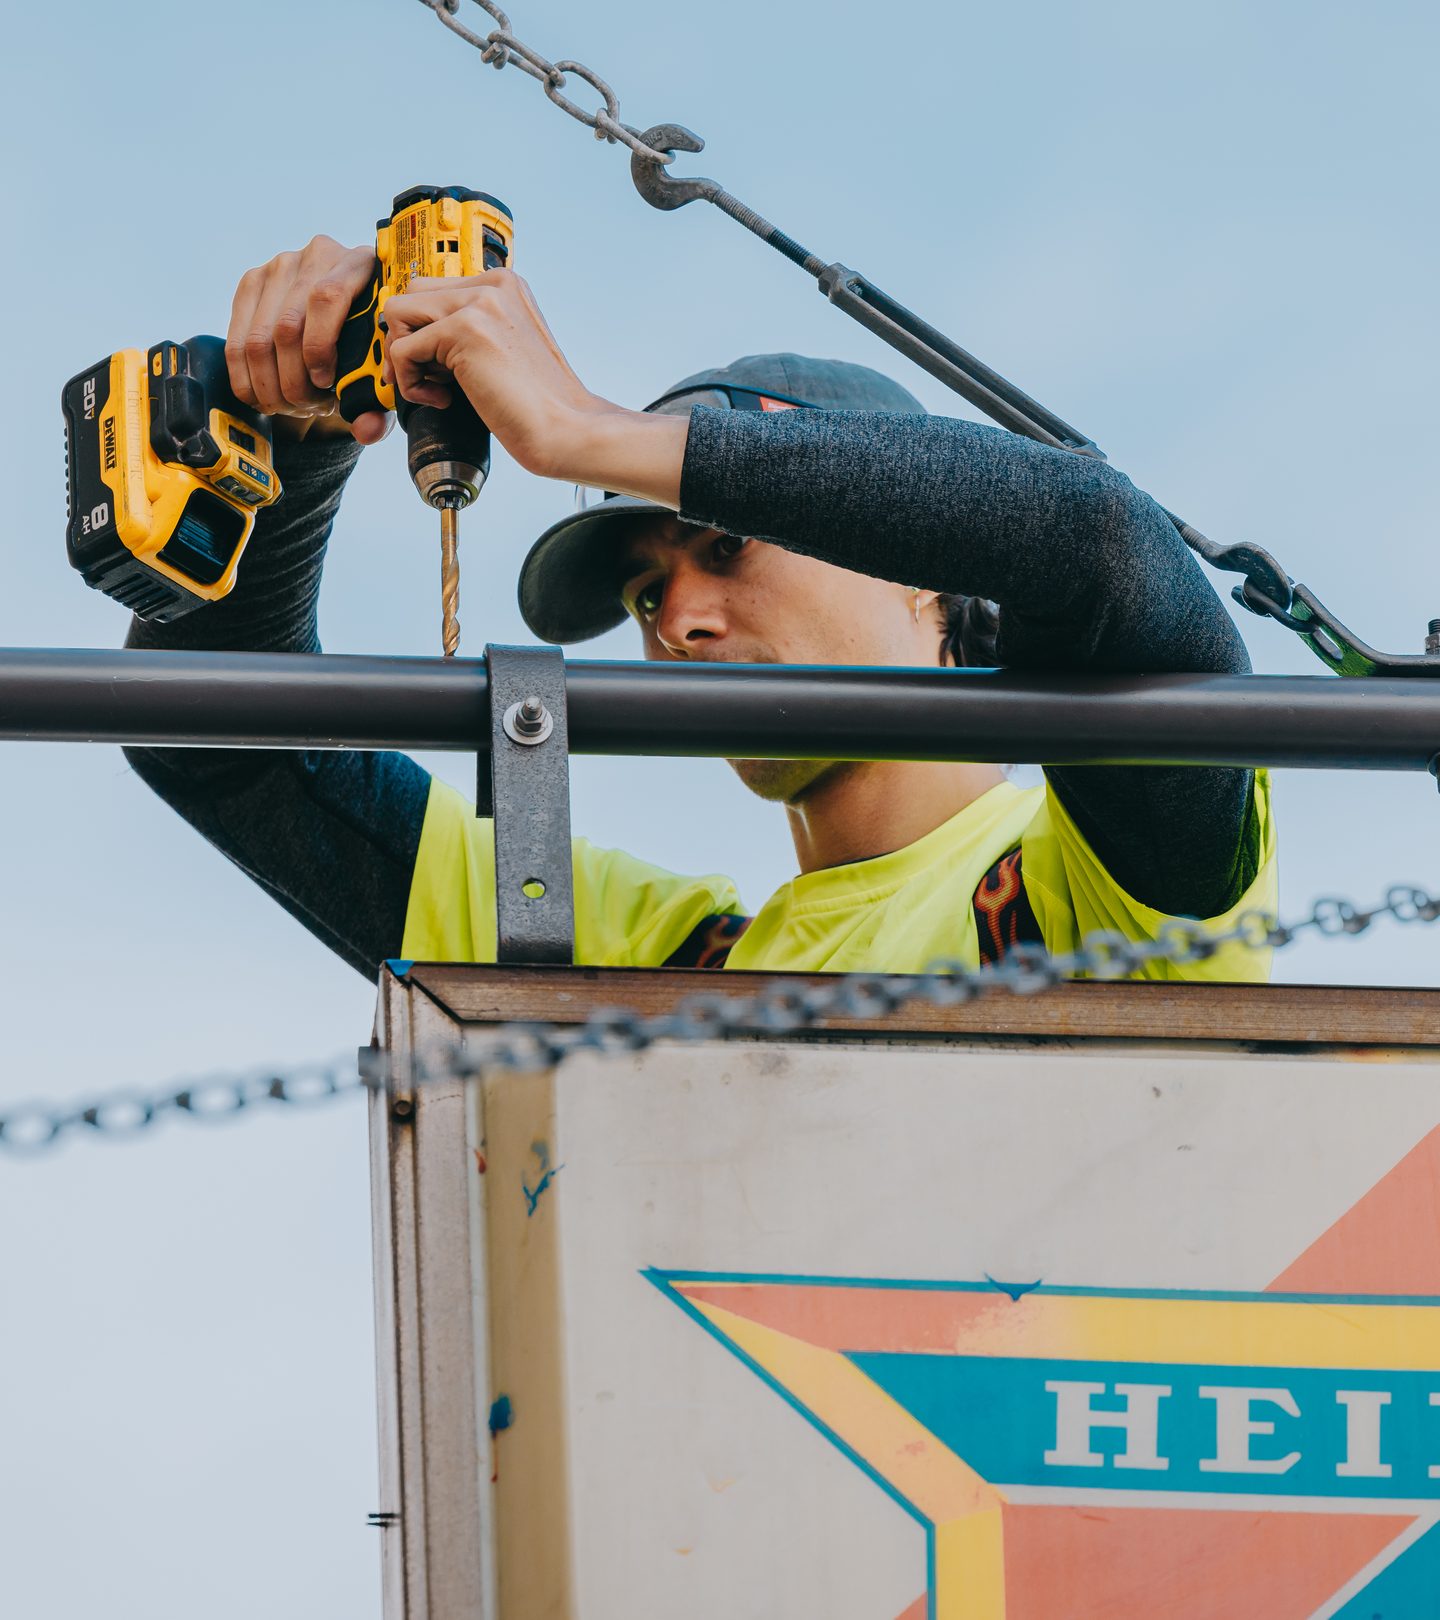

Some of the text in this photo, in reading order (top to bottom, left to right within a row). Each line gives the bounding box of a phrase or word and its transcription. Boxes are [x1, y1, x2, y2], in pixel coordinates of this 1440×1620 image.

[83, 377, 96, 421] 20V
[82, 502, 108, 535] 8 AH
[1044, 1380, 1440, 1478] HEI
